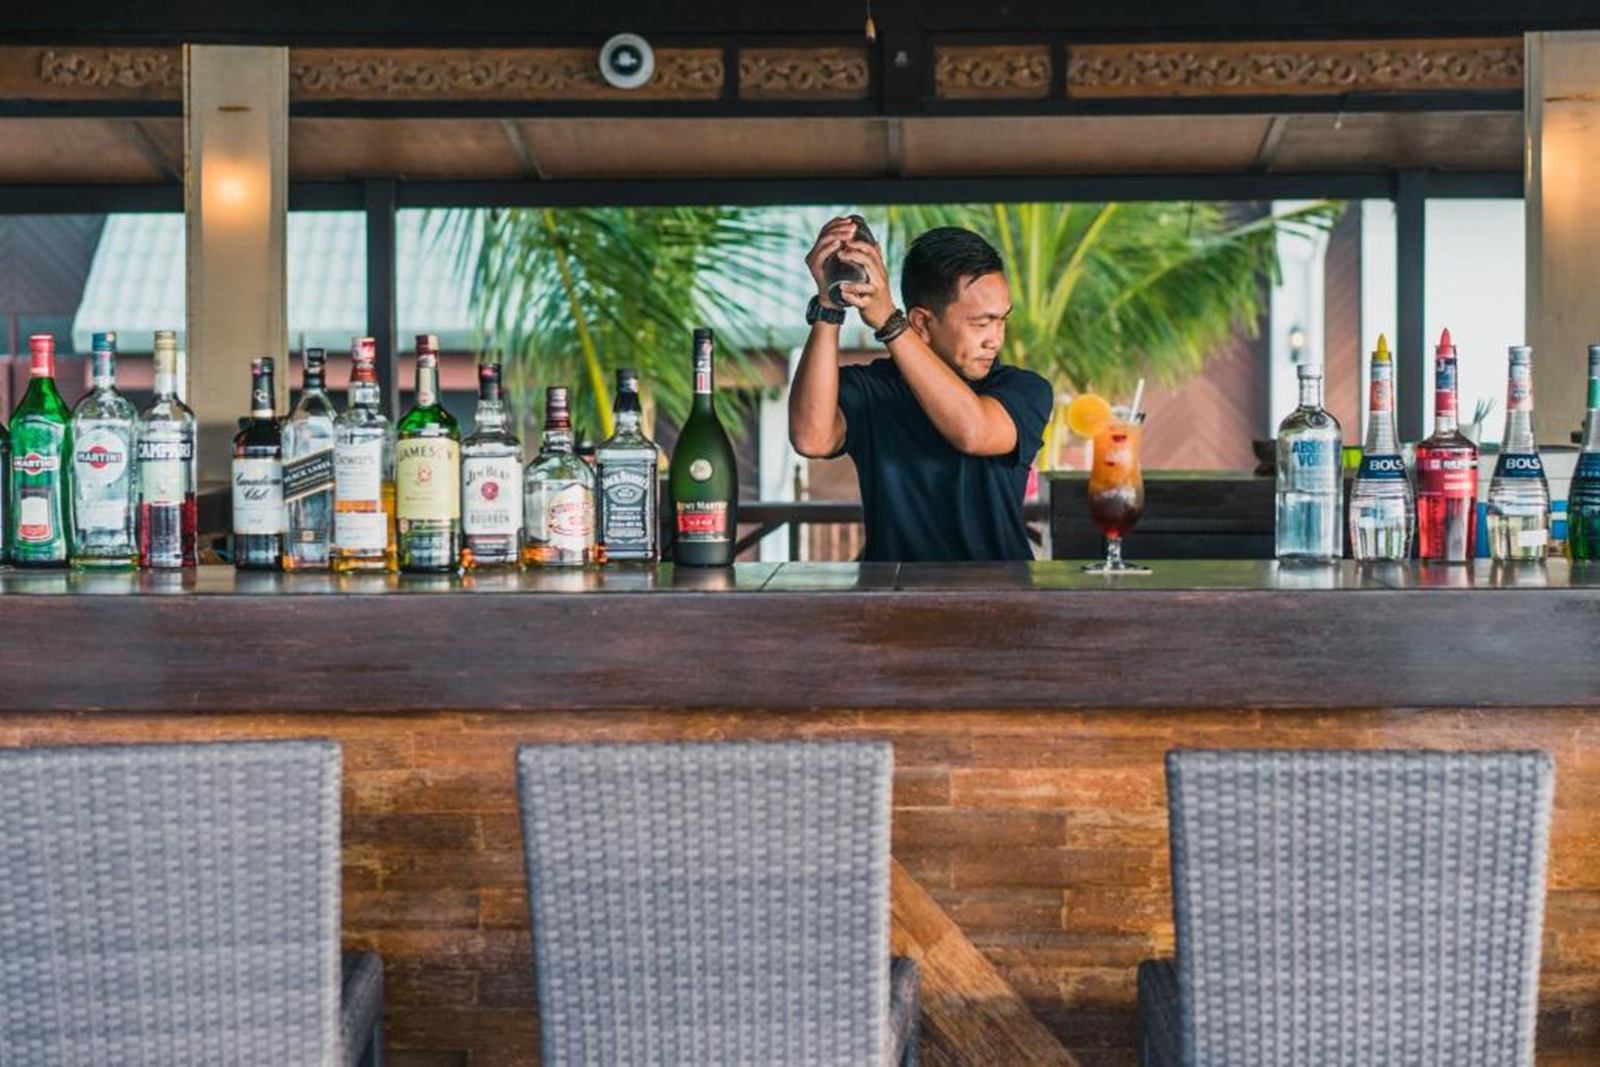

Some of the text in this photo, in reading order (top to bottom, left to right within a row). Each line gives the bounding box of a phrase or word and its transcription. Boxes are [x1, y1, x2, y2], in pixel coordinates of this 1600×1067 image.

[76, 450, 123, 463] MARTINI
[138, 442, 192, 458] CAMPARI
[399, 445, 453, 461] JAMESN
[1369, 459, 1404, 470] BOLS
[1505, 458, 1541, 469] BOLS
